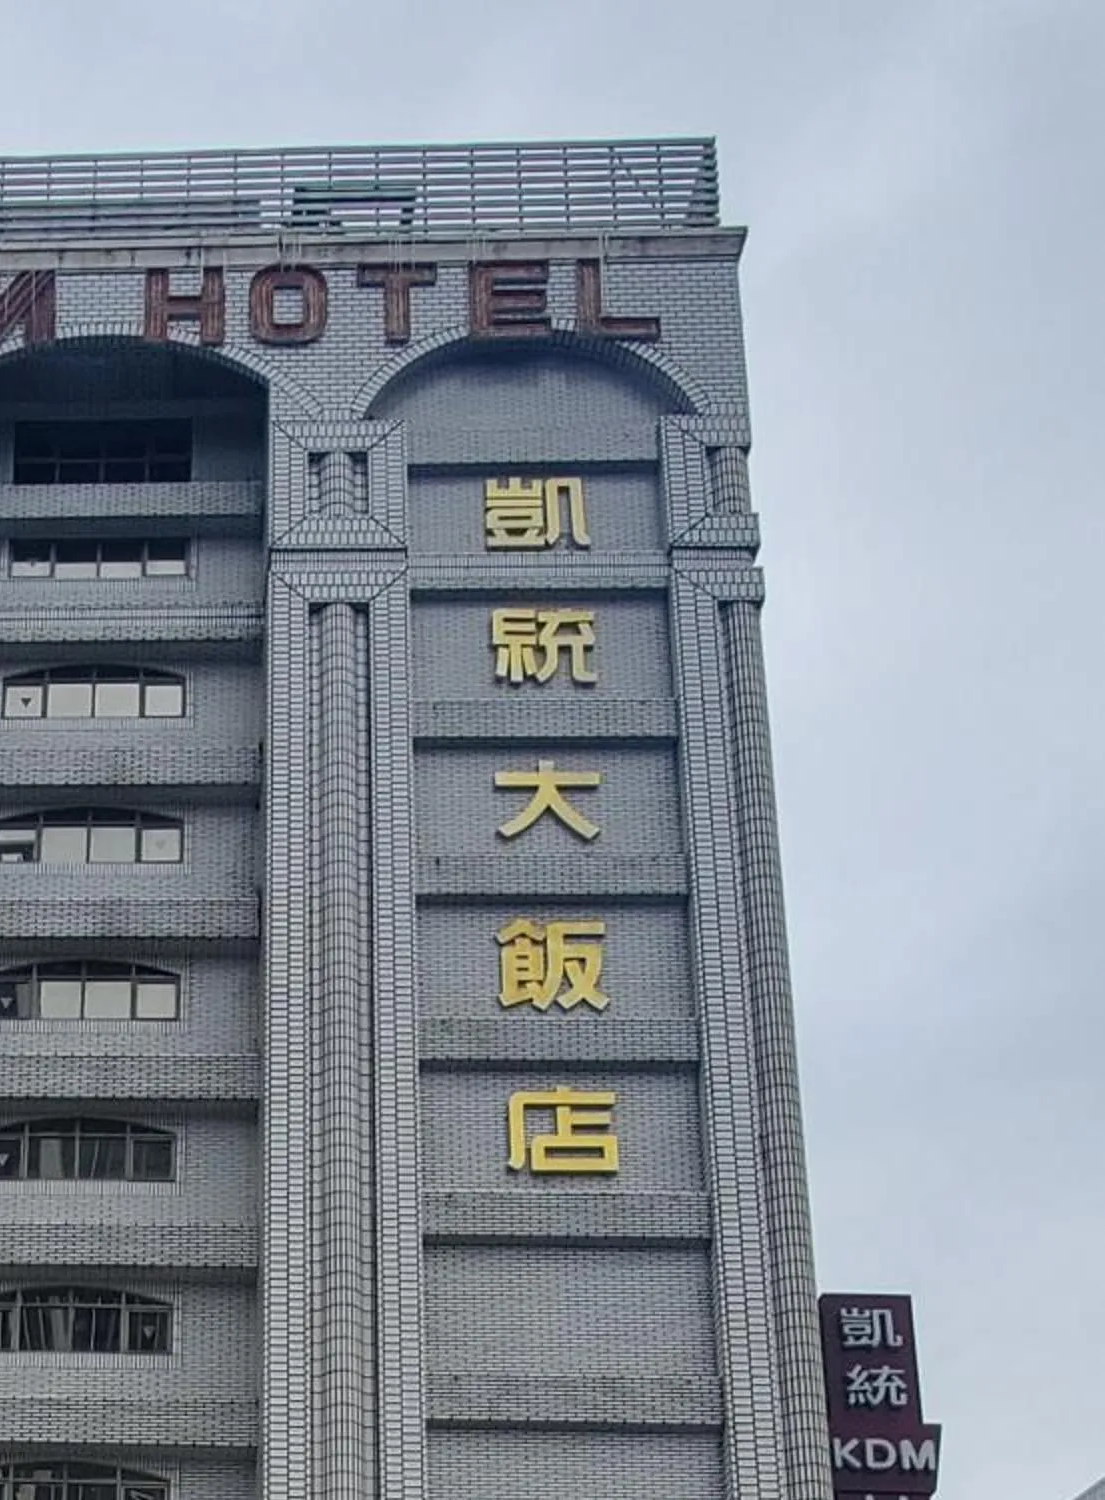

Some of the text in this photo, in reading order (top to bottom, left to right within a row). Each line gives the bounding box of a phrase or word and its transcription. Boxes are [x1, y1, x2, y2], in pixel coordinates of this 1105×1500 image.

[143, 258, 661, 346] HOTEL
[484, 476, 620, 1175] 凱統大飯店
[839, 1307, 908, 1406] 凱統
[833, 1437, 937, 1472] KDM
